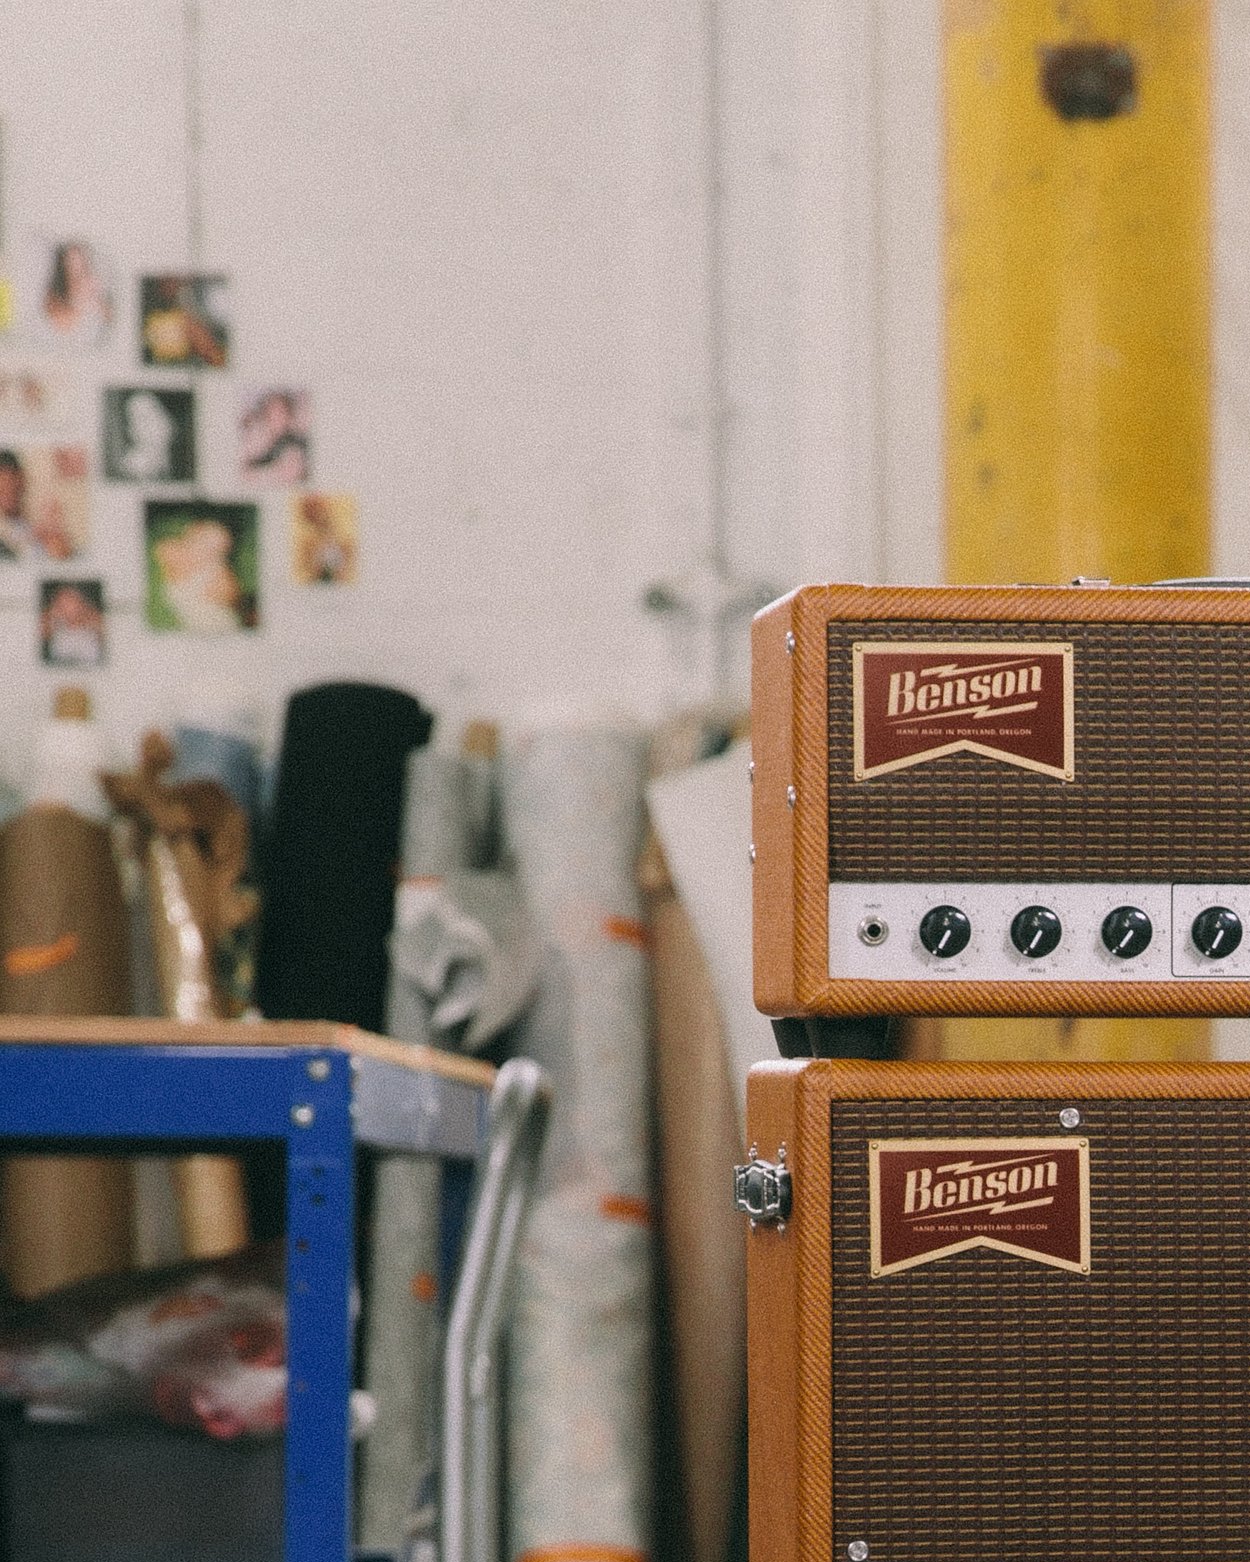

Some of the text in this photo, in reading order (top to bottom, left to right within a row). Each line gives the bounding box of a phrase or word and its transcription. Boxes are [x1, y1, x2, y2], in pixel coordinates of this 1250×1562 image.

[886, 665, 1042, 717] Benson
[896, 728, 919, 736] HAND
[921, 728, 942, 736] MADE
[945, 728, 955, 736] IN
[998, 728, 1032, 736] OREGON
[903, 1160, 1059, 1215] Benson
[1014, 1223, 1049, 1231] OREGON
